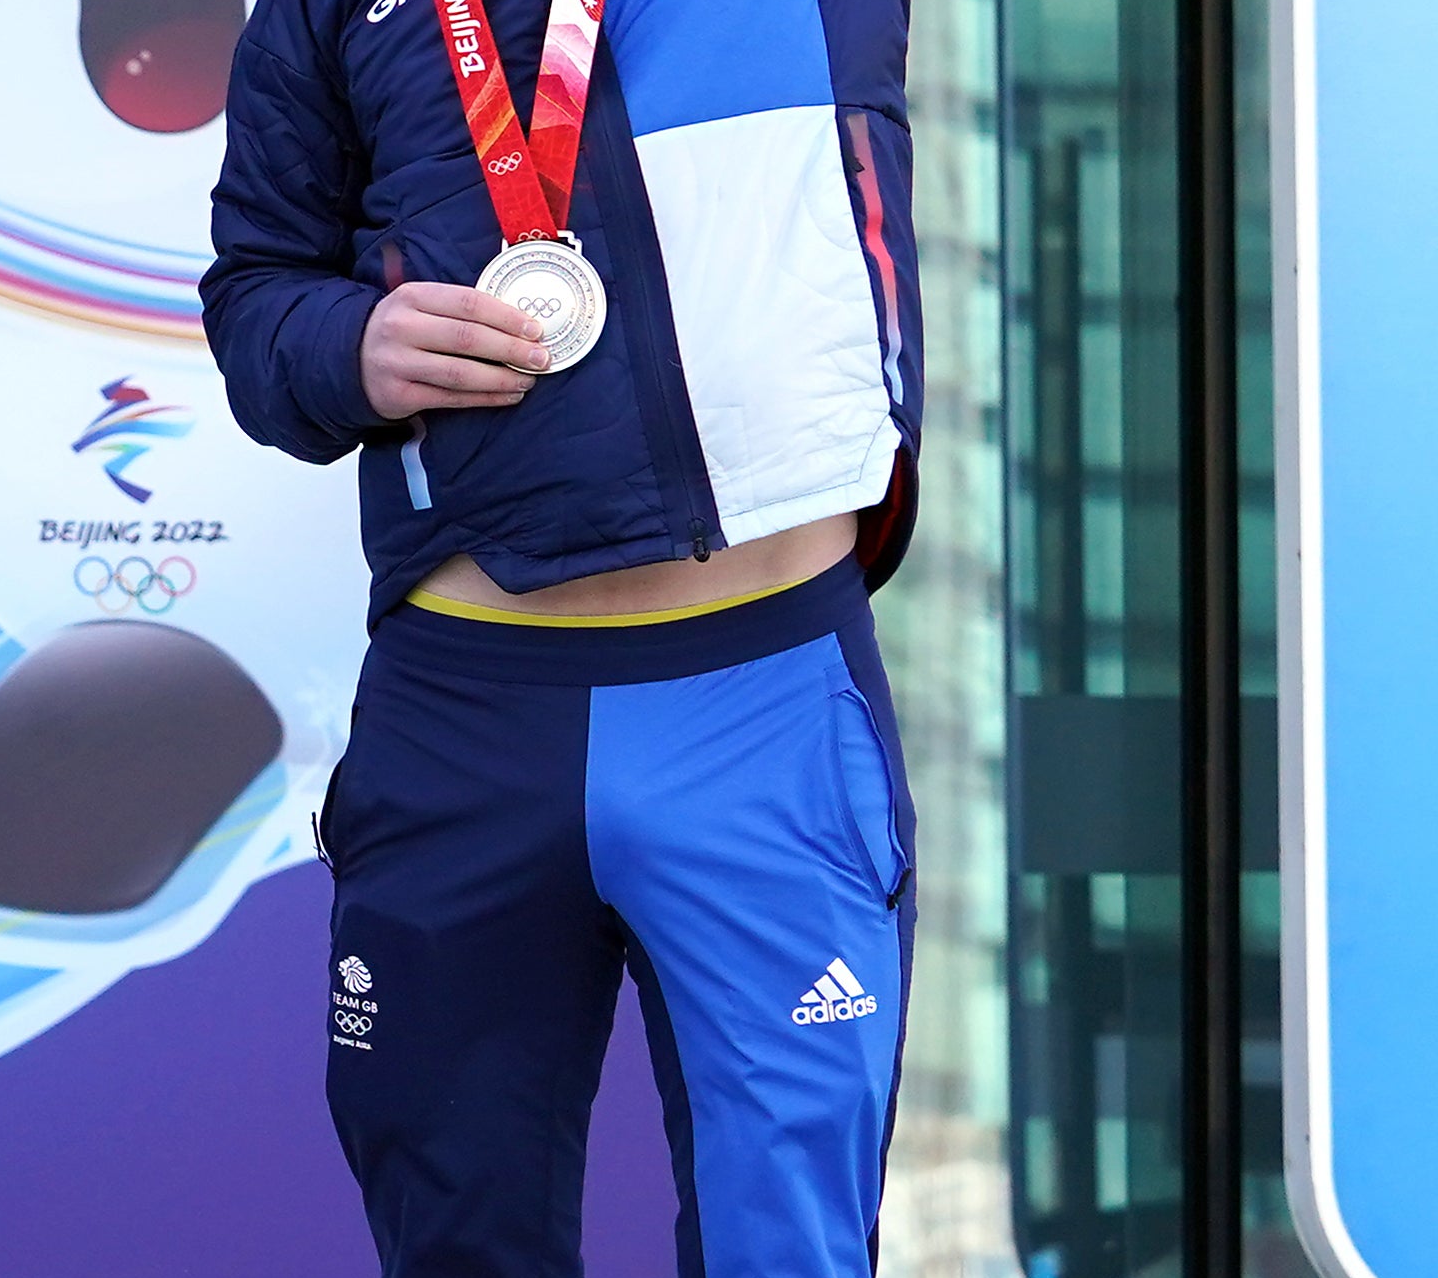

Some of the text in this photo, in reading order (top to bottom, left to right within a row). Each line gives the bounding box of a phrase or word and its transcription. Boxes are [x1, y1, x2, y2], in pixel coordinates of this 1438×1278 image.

[38, 519, 230, 549] BEIJING 2022
[332, 991, 379, 1014] TEAM GB
[791, 994, 878, 1026] adidas
